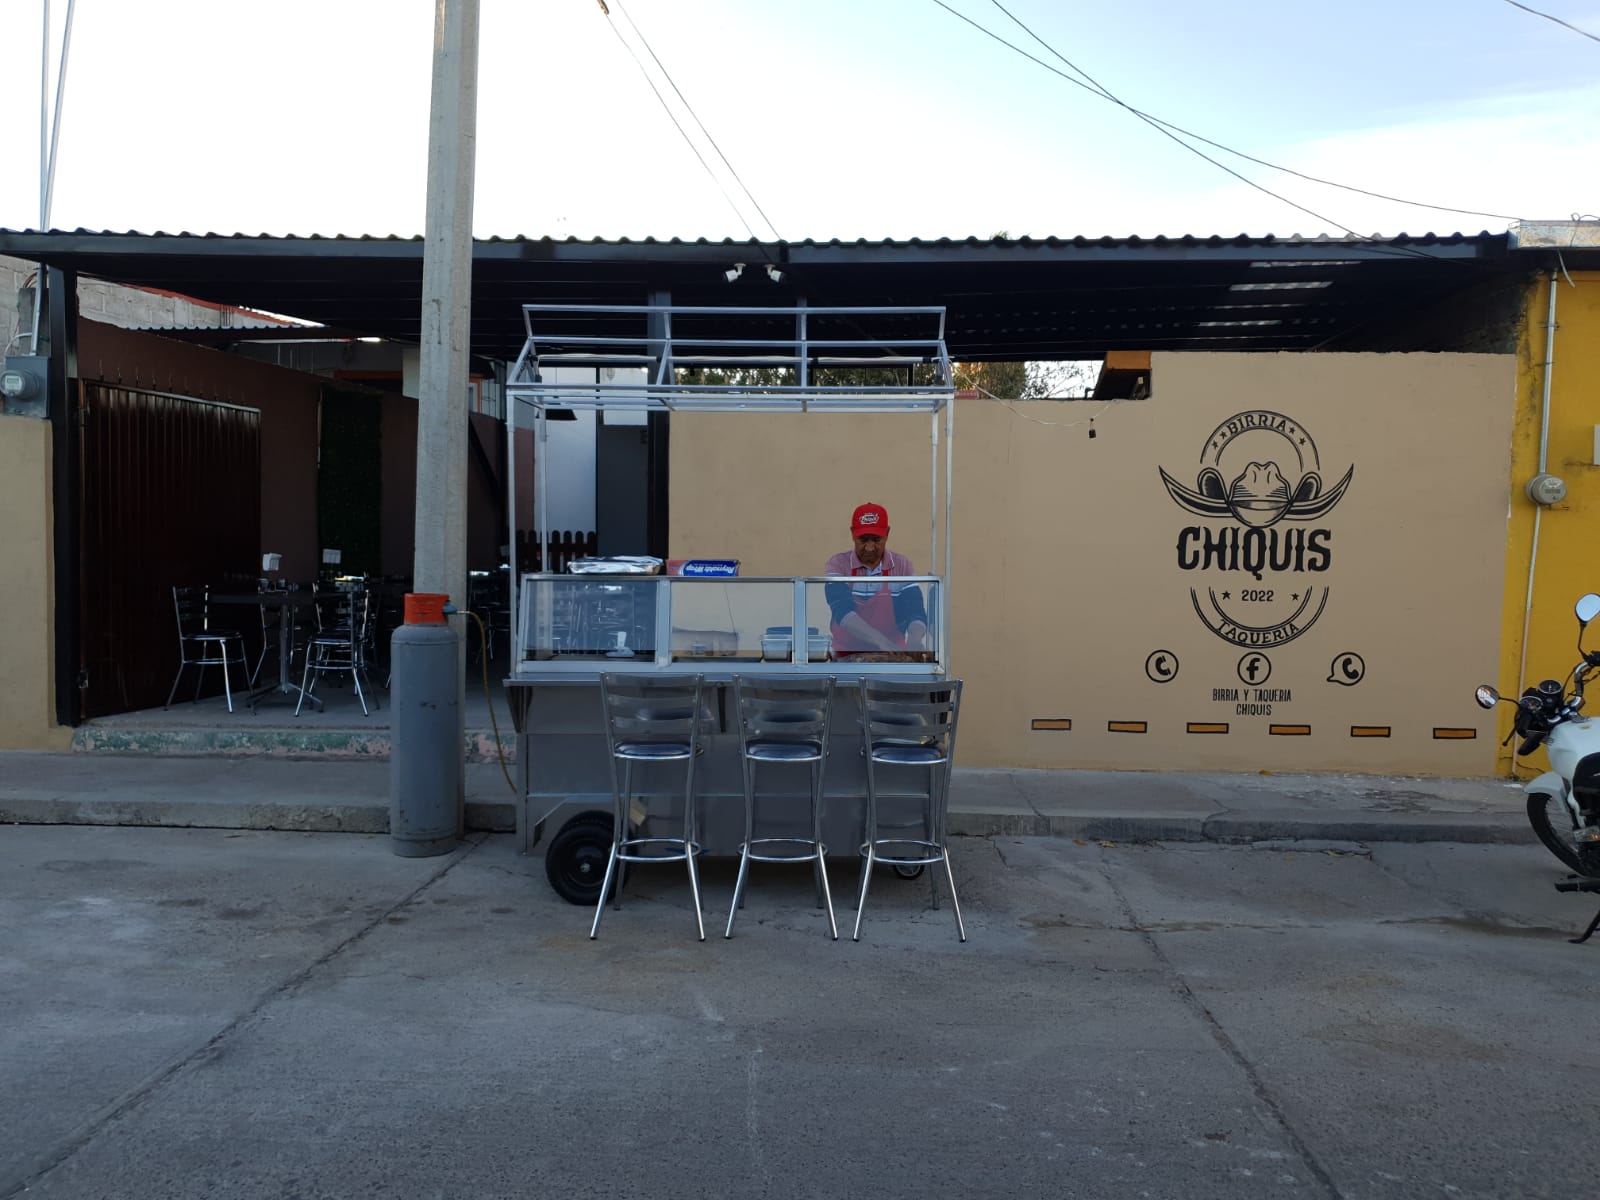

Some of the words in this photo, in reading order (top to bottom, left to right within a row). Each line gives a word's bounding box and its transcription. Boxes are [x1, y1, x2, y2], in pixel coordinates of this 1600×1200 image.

[1226, 413, 1287, 436] BIRRIA
[1176, 526, 1332, 581] CHIQUIS
[1241, 589, 1274, 602] 2022
[1217, 618, 1300, 644] TAQUERIA
[1212, 688, 1239, 702] BIRRIA
[1243, 688, 1250, 702] Y
[1253, 688, 1292, 703] TAQUERIA
[1236, 703, 1273, 716] CHIQUIS
